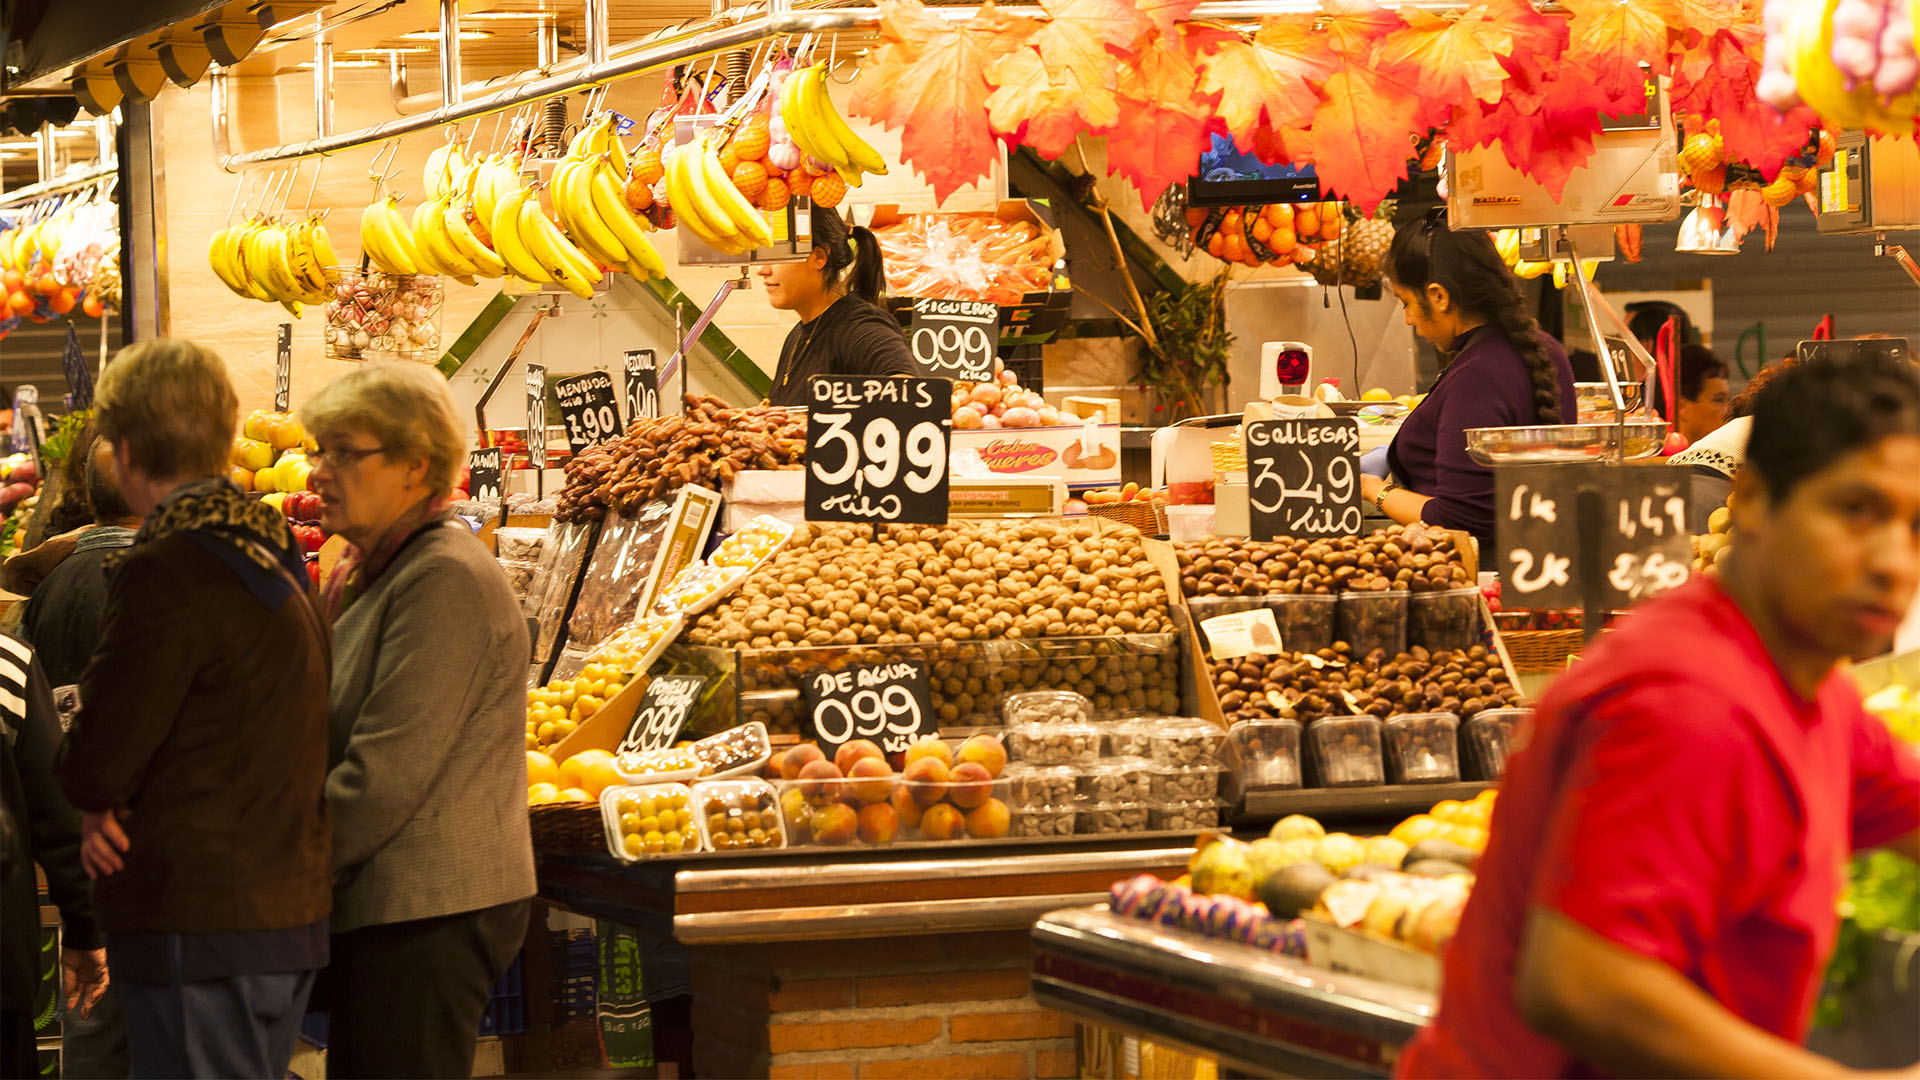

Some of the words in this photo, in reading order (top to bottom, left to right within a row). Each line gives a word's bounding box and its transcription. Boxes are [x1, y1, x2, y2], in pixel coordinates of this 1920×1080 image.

[813, 380, 862, 404] DEL
[811, 412, 946, 495] 3,99
[813, 672, 853, 697] DE
[857, 663, 918, 687] AGUA
